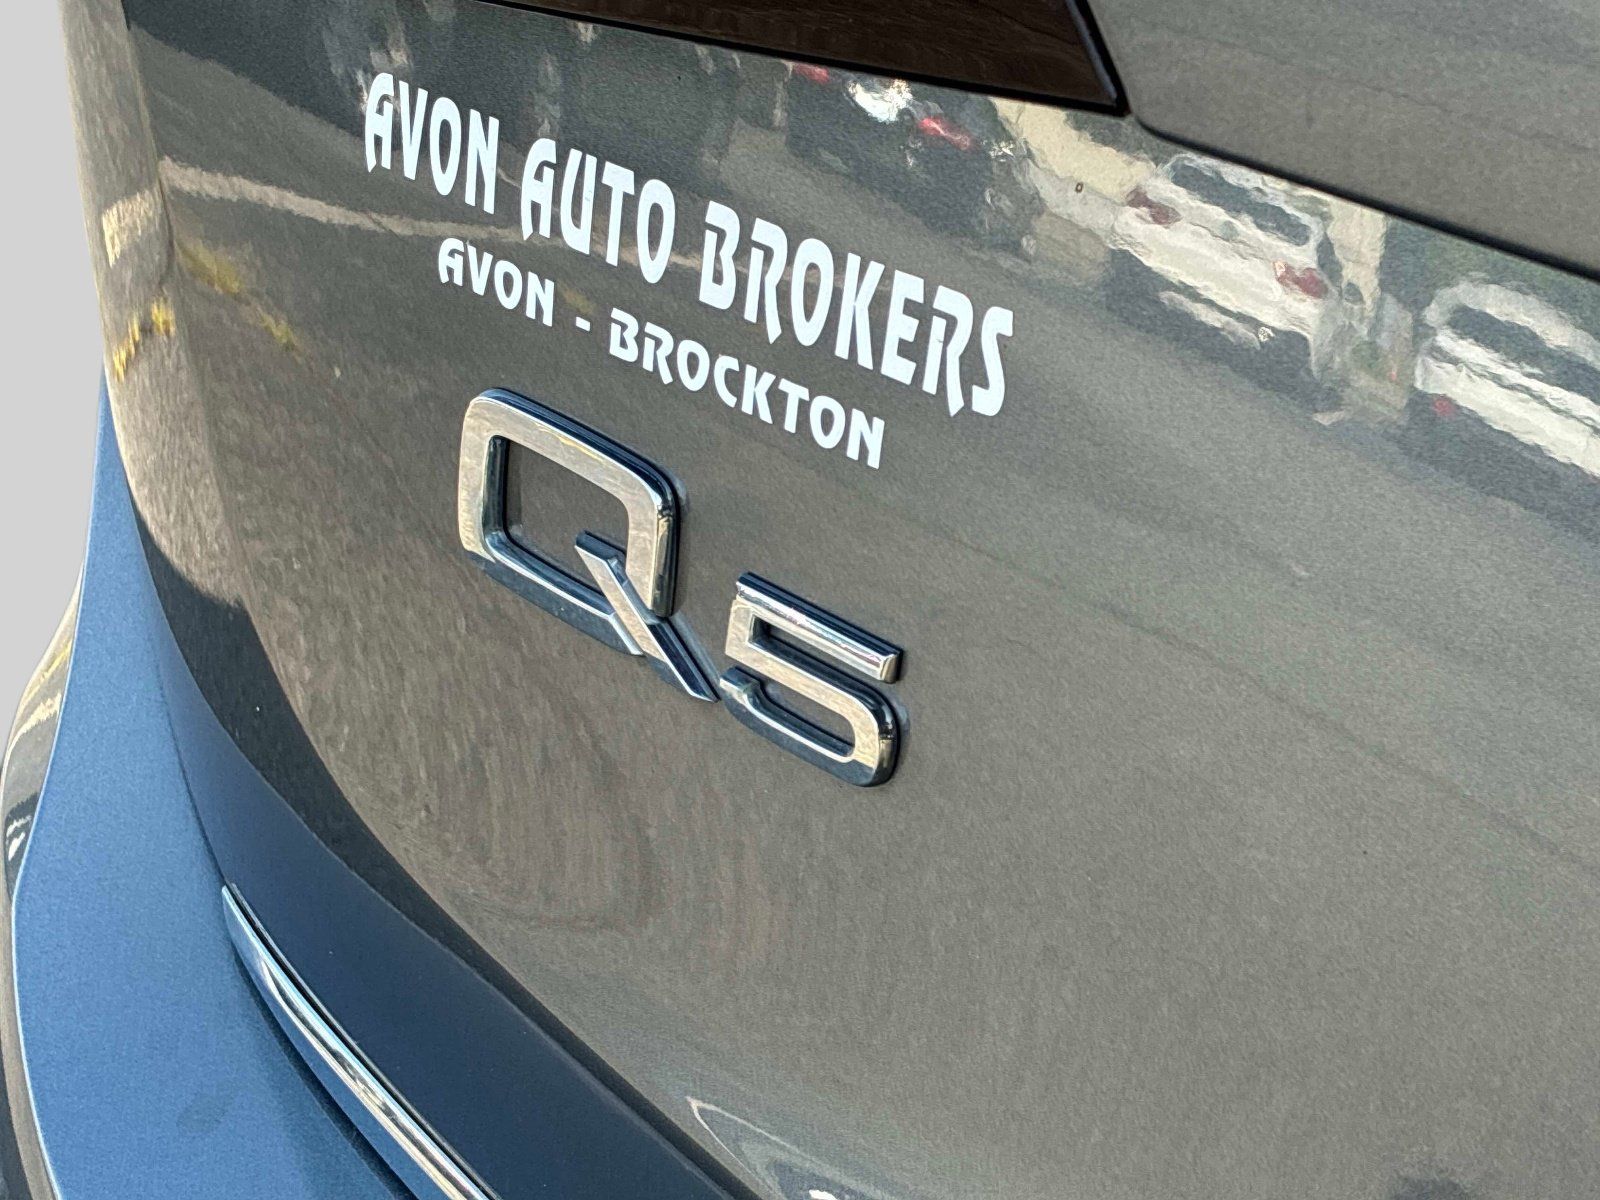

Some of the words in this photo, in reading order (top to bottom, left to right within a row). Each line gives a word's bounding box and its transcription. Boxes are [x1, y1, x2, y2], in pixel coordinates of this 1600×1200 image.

[364, 72, 500, 215] AVON
[520, 137, 676, 284] AUTO
[699, 200, 1014, 418] BROKERS
[437, 237, 555, 327] AVON
[609, 307, 885, 470] BROCKTON
[458, 387, 903, 788] Q5
